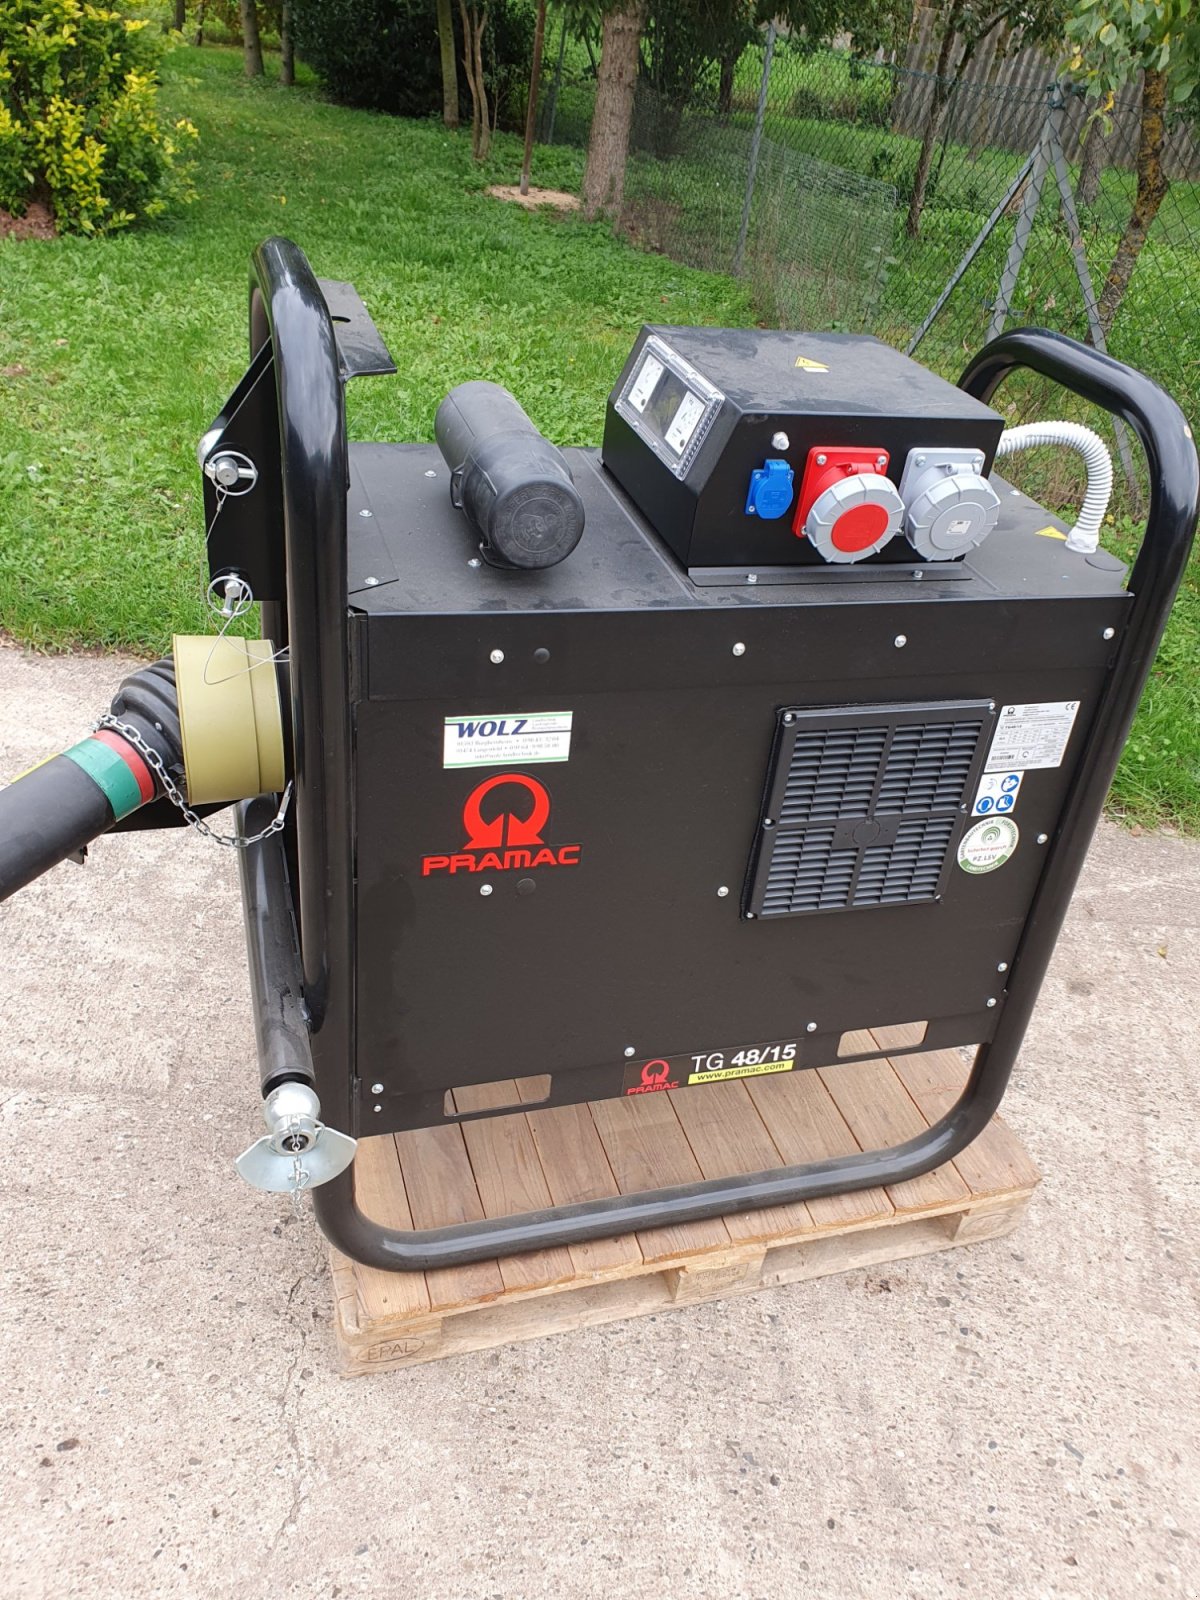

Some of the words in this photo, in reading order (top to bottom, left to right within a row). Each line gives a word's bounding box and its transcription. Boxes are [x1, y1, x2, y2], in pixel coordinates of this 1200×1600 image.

[457, 719, 528, 738] WOLZ
[422, 845, 581, 876] PRAMAC
[691, 1052, 724, 1073] TG
[730, 1043, 797, 1066] 48/15
[697, 1062, 785, 1081] www.pramac.com
[626, 1080, 680, 1096] PRAMAC
[367, 1341, 415, 1361] EPAL
